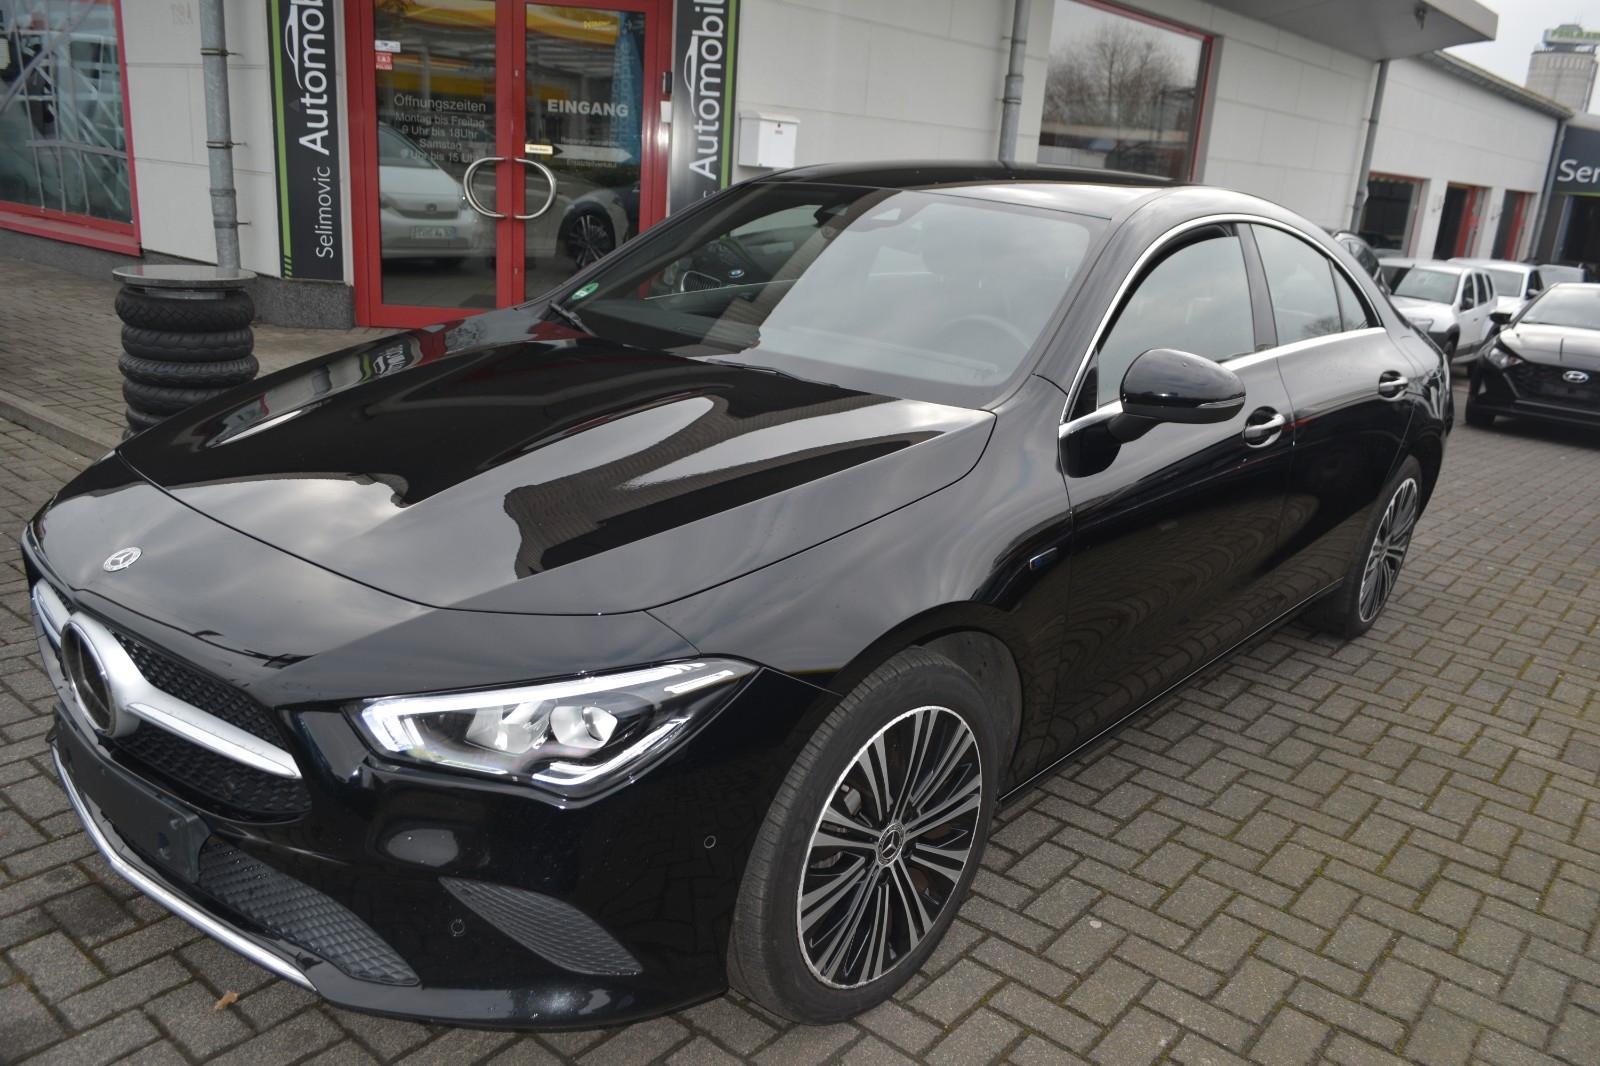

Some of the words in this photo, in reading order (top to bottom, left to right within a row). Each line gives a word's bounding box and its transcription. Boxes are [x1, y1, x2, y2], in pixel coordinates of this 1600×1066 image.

[547, 98, 629, 118] EINGANG
[395, 111, 433, 126] Montag
[434, 116, 449, 126] bis
[451, 115, 485, 129] Freitag
[411, 125, 429, 136] Uhr
[431, 126, 446, 137] bis
[419, 138, 462, 151] Samstag
[313, 166, 334, 259] Selimovic
